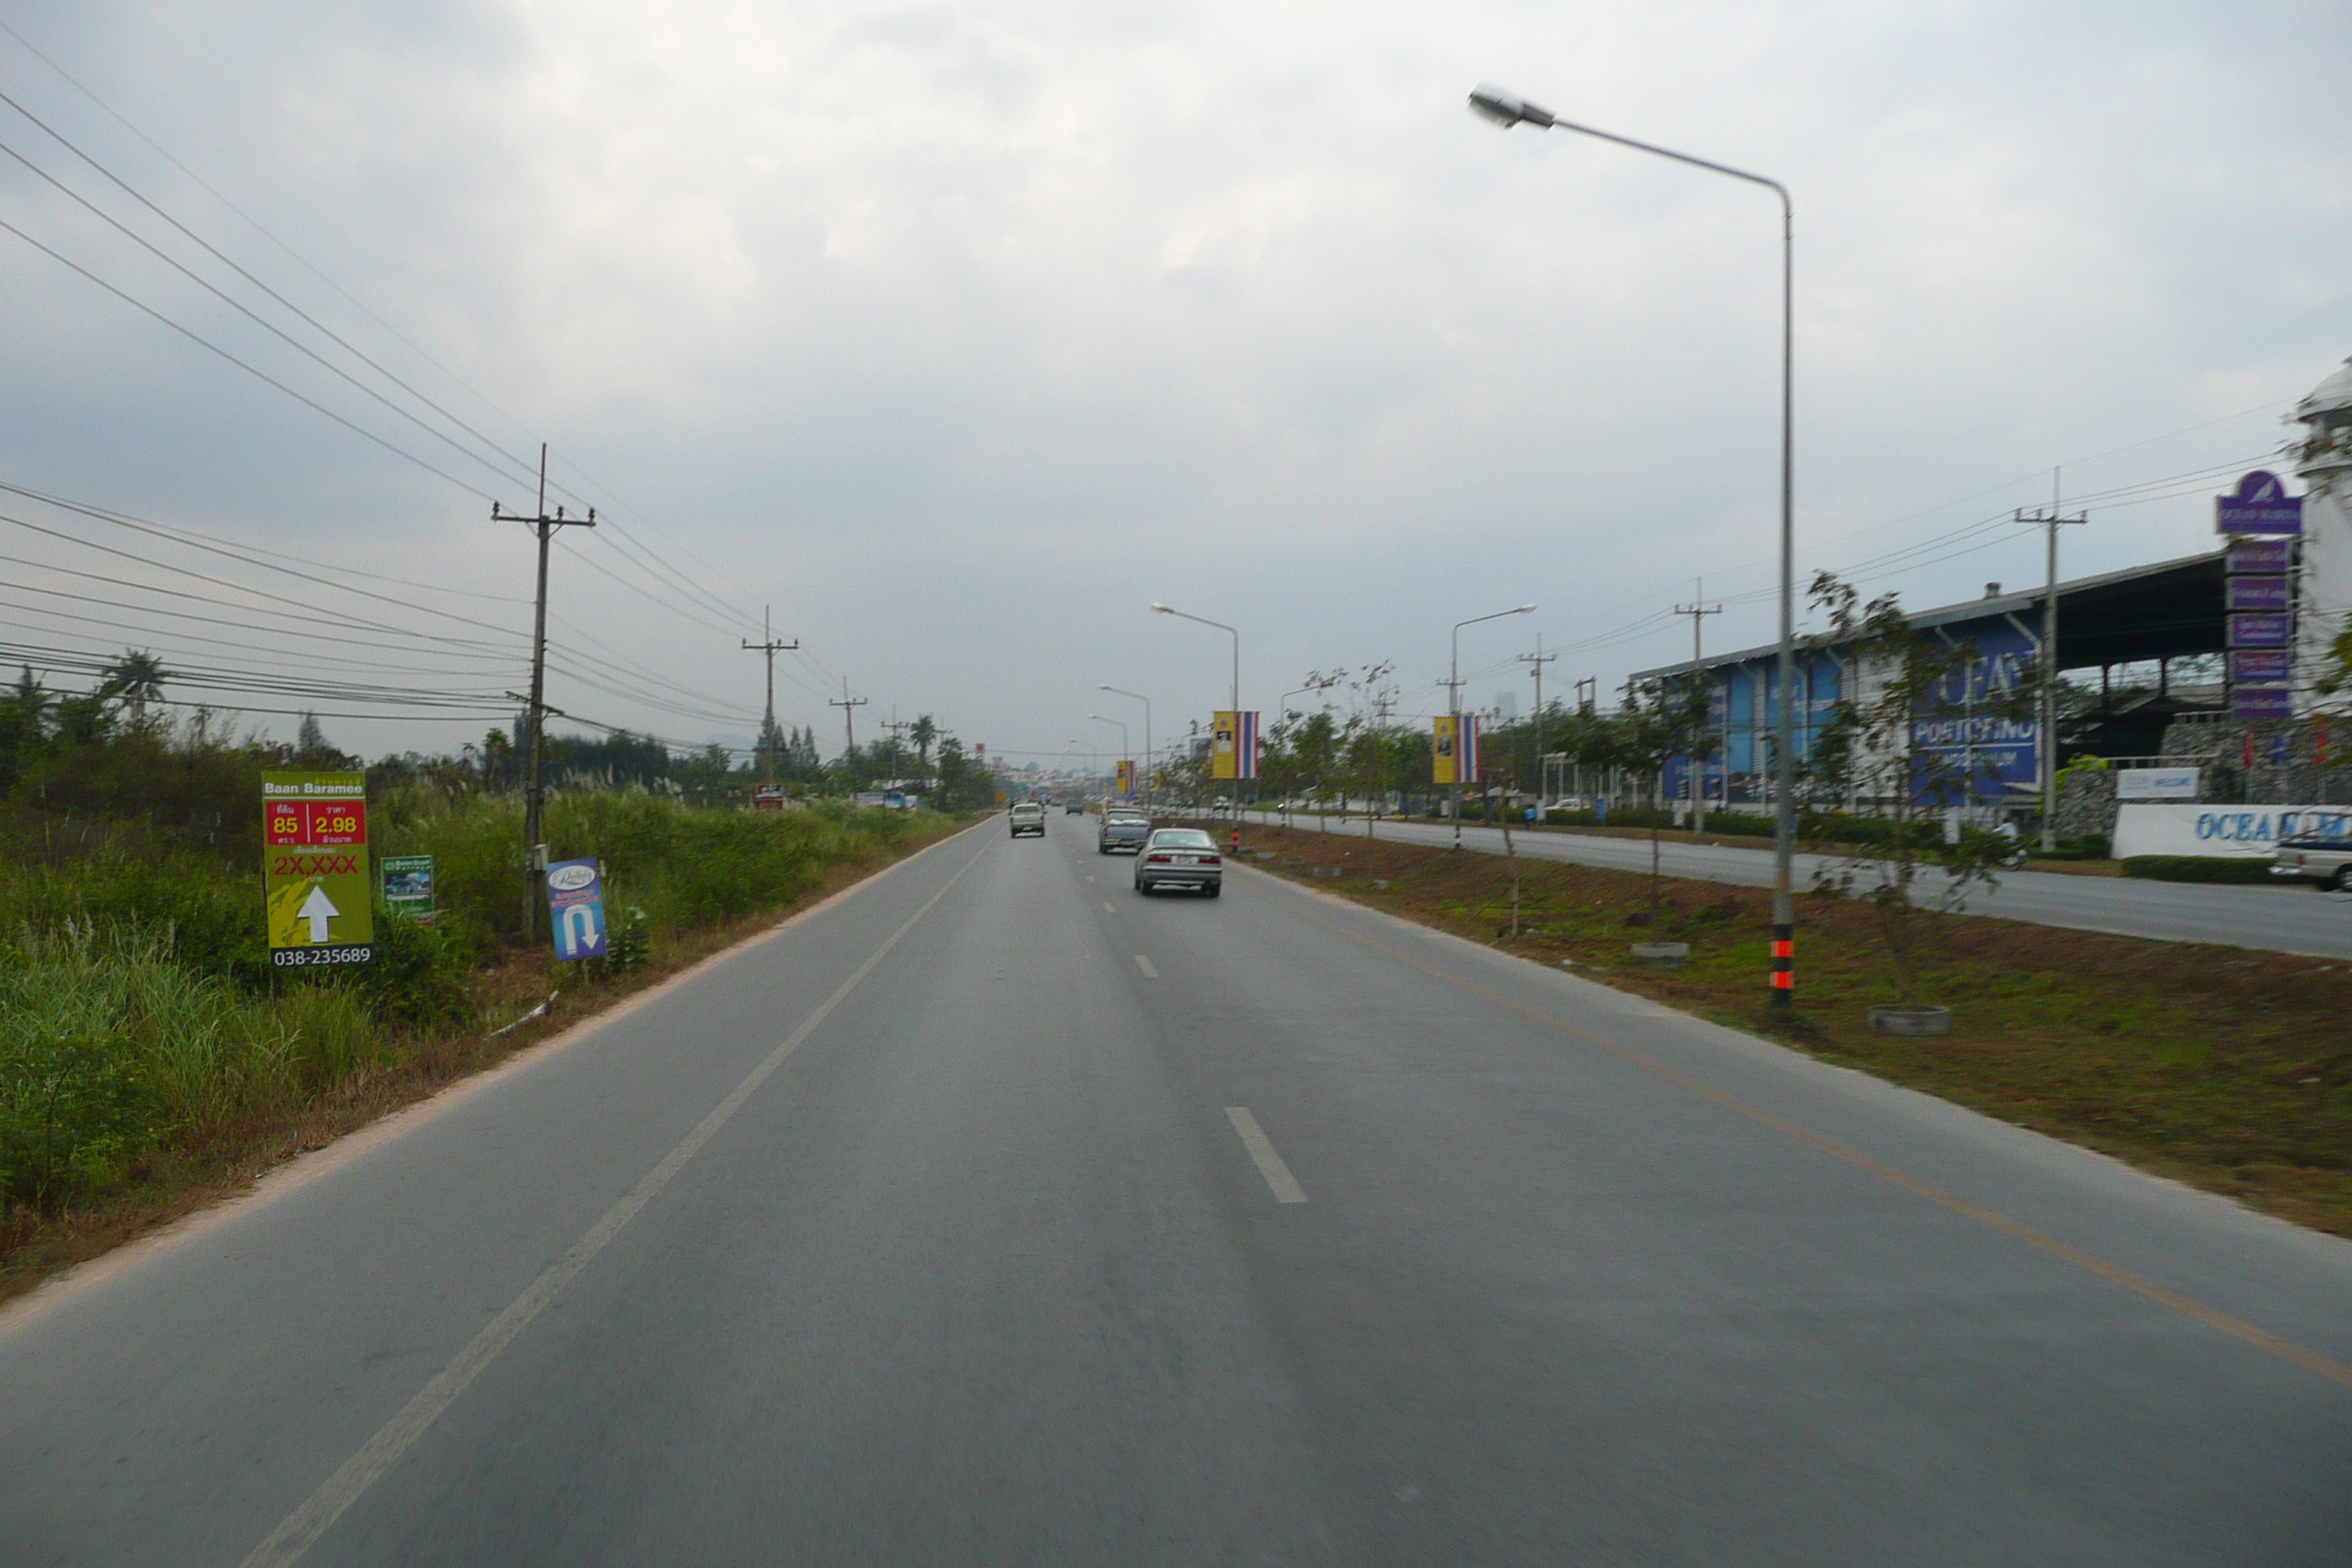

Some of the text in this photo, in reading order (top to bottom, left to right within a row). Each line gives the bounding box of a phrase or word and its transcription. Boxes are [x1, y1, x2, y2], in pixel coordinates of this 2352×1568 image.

[264, 783, 363, 794] Baan Baramee
[274, 816, 299, 834] 85
[314, 816, 358, 834] 2.98
[274, 854, 358, 877] 2X,XXX
[274, 947, 371, 966] 038-235689
